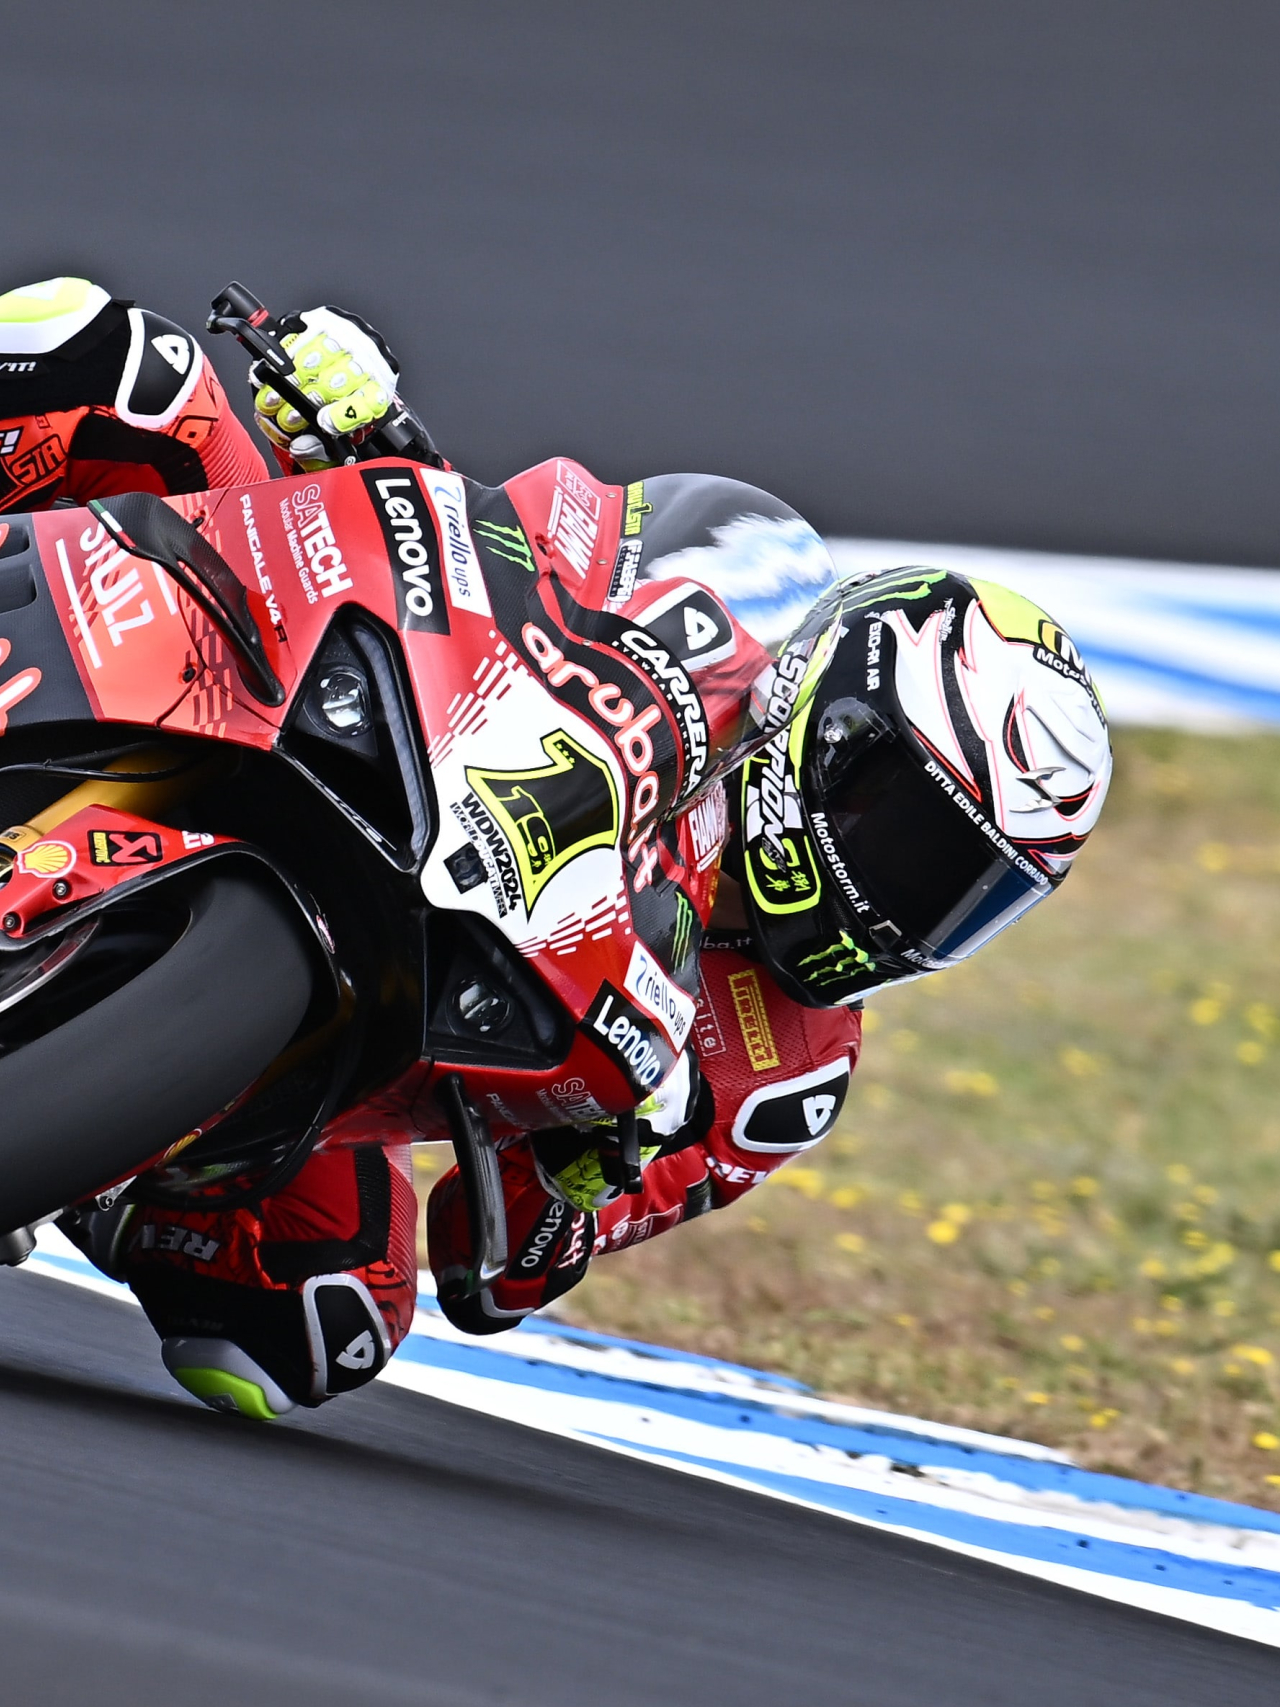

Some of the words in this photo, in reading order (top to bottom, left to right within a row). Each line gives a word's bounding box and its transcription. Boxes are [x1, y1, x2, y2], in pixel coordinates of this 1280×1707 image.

[239, 493, 273, 595] PANIGALE
[278, 496, 294, 533] Modular
[286, 528, 305, 570] Machine
[298, 566, 320, 605] Guards
[291, 483, 355, 599] SATECH
[375, 477, 434, 618] Lenovo
[443, 503, 472, 565] riello
[451, 567, 471, 598] ups
[553, 493, 599, 581] FIAMM
[611, 640, 673, 701] EYEWEAR
[676, 711, 690, 760] SINCE
[620, 629, 708, 797] CARRERA
[866, 664, 881, 691] AIR
[461, 791, 523, 912] WDW2024
[810, 811, 871, 914] Motostorm.it
[923, 760, 956, 796] DITTA
[952, 791, 985, 826] EDILE
[980, 821, 1019, 860] BALDINI
[1014, 856, 1049, 886] CORRADO
[593, 994, 661, 1086] Lenovo
[645, 971, 676, 1019] riello
[673, 1010, 686, 1036] ups
[520, 1199, 566, 1269] enovo
